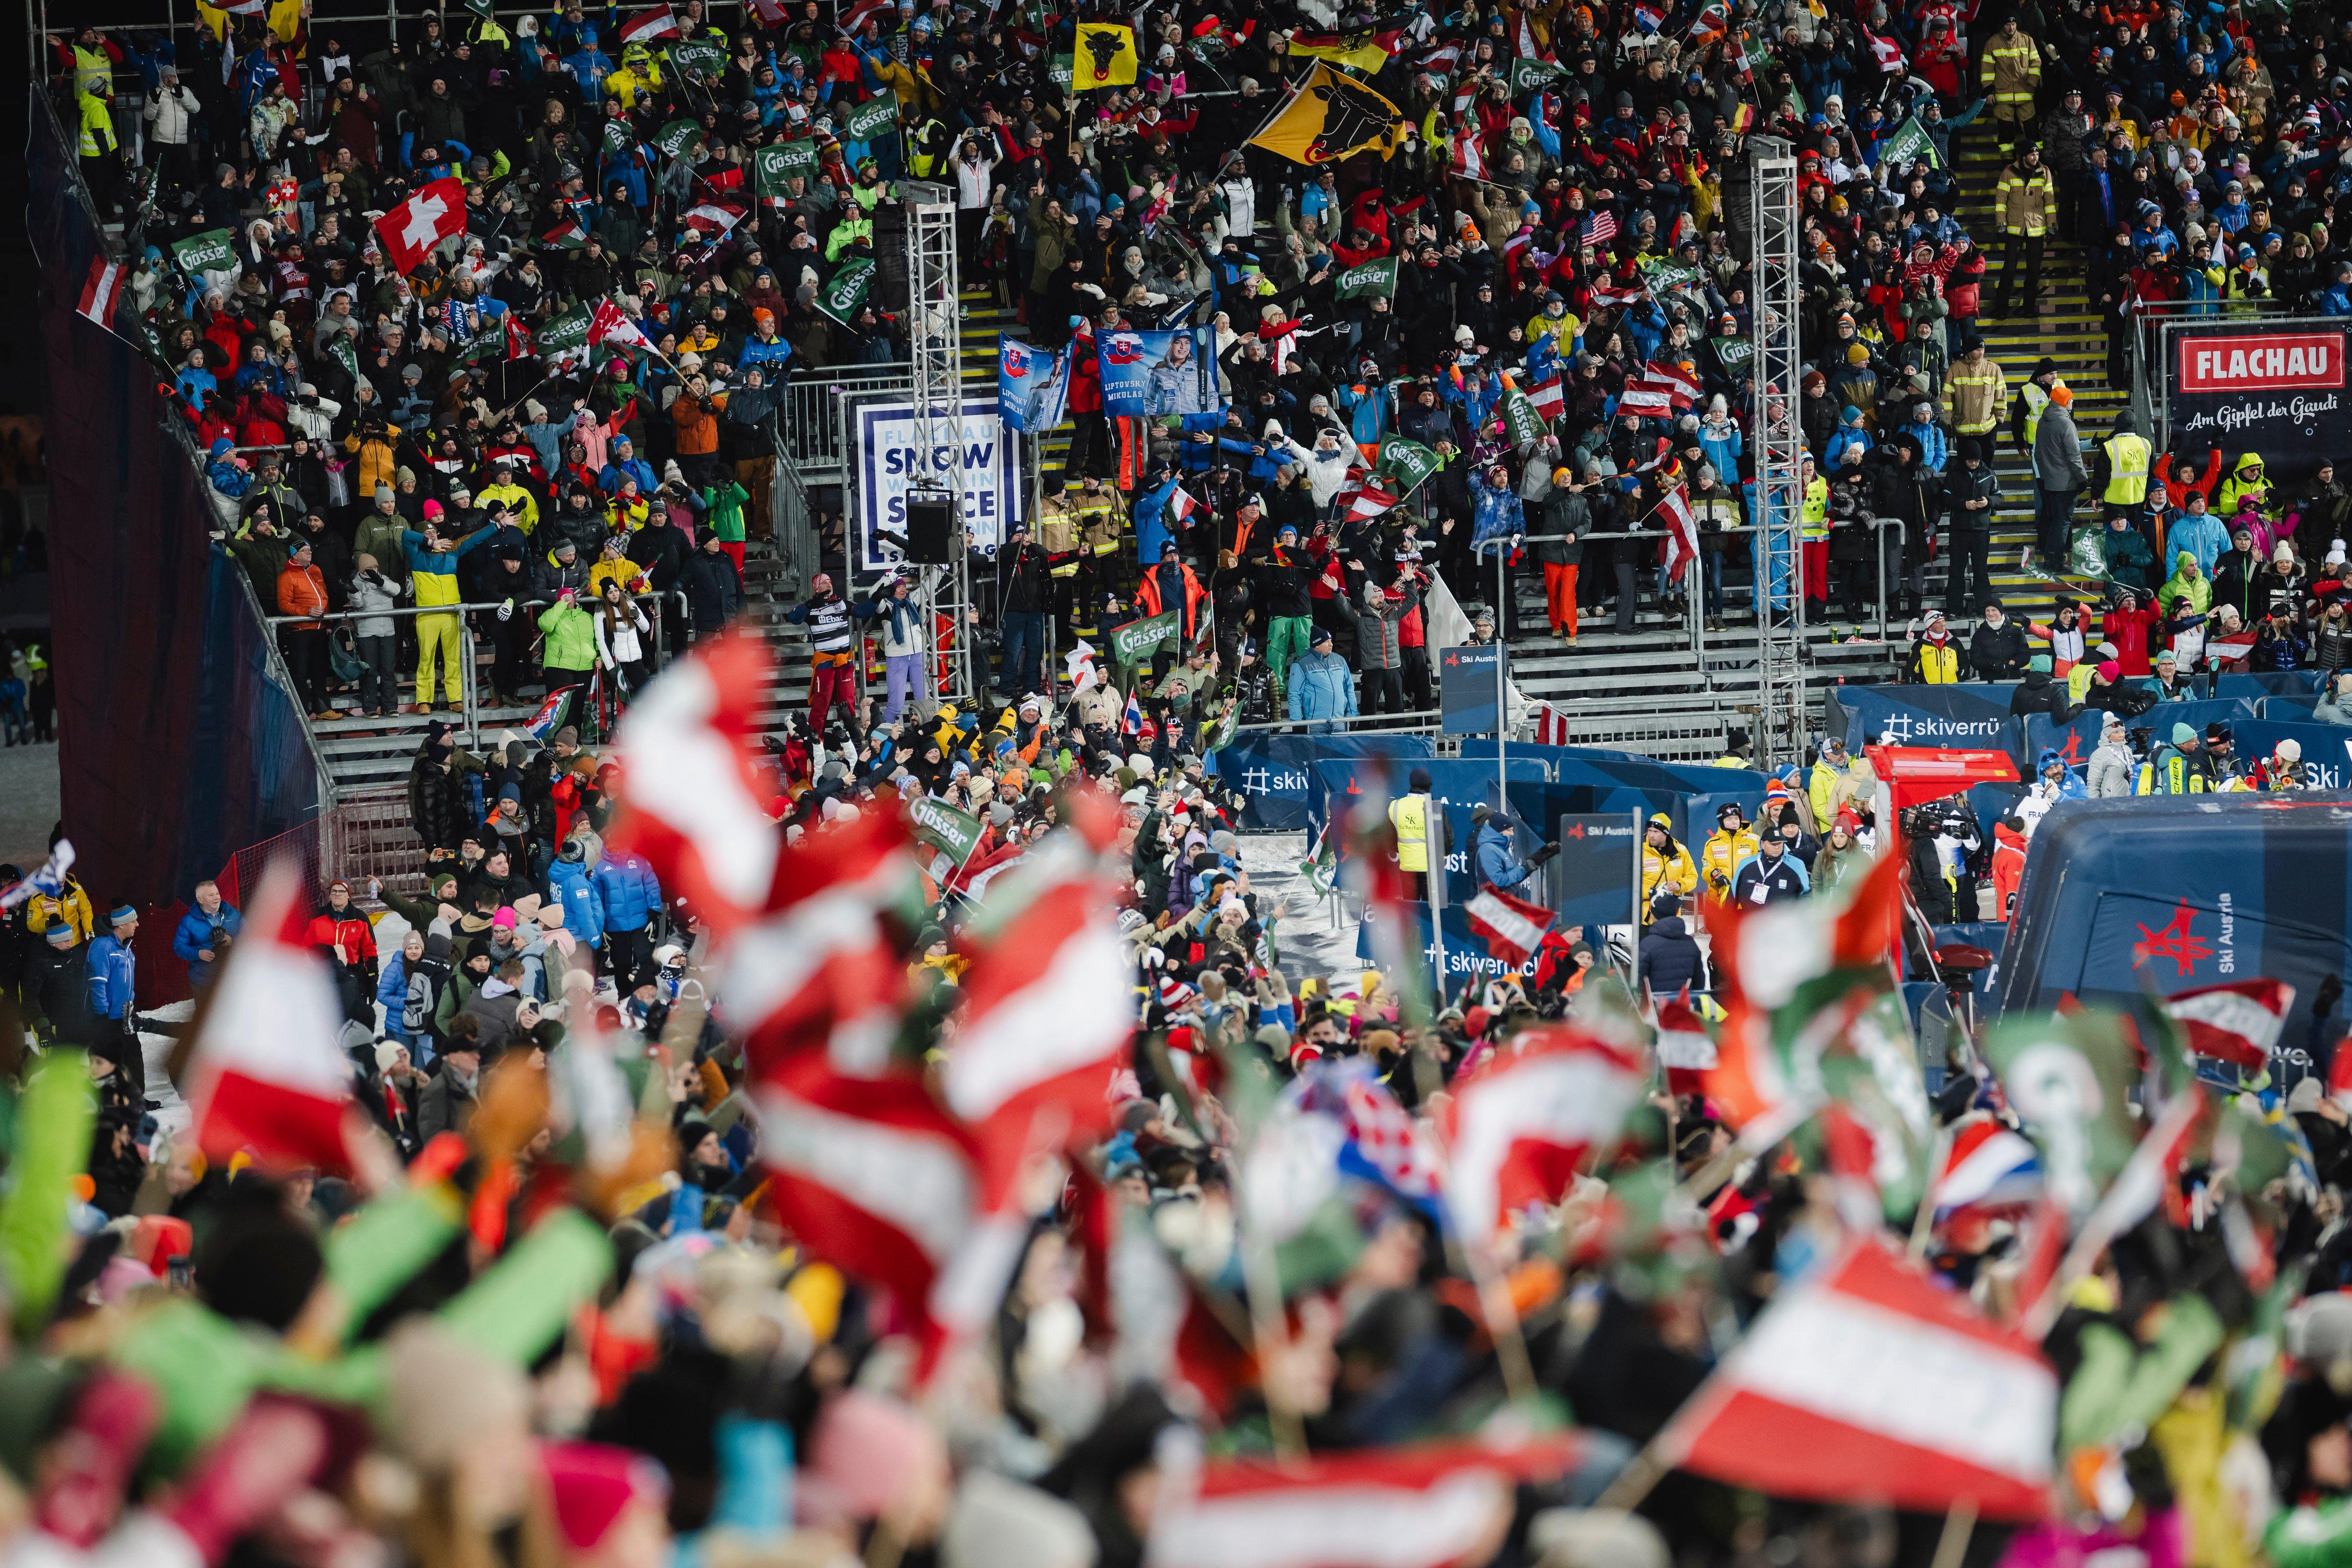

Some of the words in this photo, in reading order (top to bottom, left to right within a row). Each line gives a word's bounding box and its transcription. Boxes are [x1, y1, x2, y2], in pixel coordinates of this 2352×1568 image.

[850, 107, 894, 137] Gösser
[765, 151, 813, 173] Gösser
[178, 245, 227, 270] Gösser
[1342, 271, 1390, 290] Gösser
[2197, 347, 2327, 379] FLACHAU
[2186, 412, 2216, 431] Am
[2267, 402, 2289, 418] der
[885, 443, 994, 475] SNOW
[2127, 449, 2139, 460] SK
[887, 491, 995, 523] SCE
[825, 615, 844, 623] Ebac
[1119, 626, 1173, 653] Gösser
[1475, 654, 1498, 663] Austri
[2070, 676, 2078, 687] SK
[1883, 713, 2003, 742] #skiverrü
[2305, 762, 2338, 789] Ski
[1404, 814, 1417, 825] SK
[1588, 826, 1603, 836] Ski
[2219, 893, 2234, 945] Austria
[2219, 949, 2234, 974] Ski
